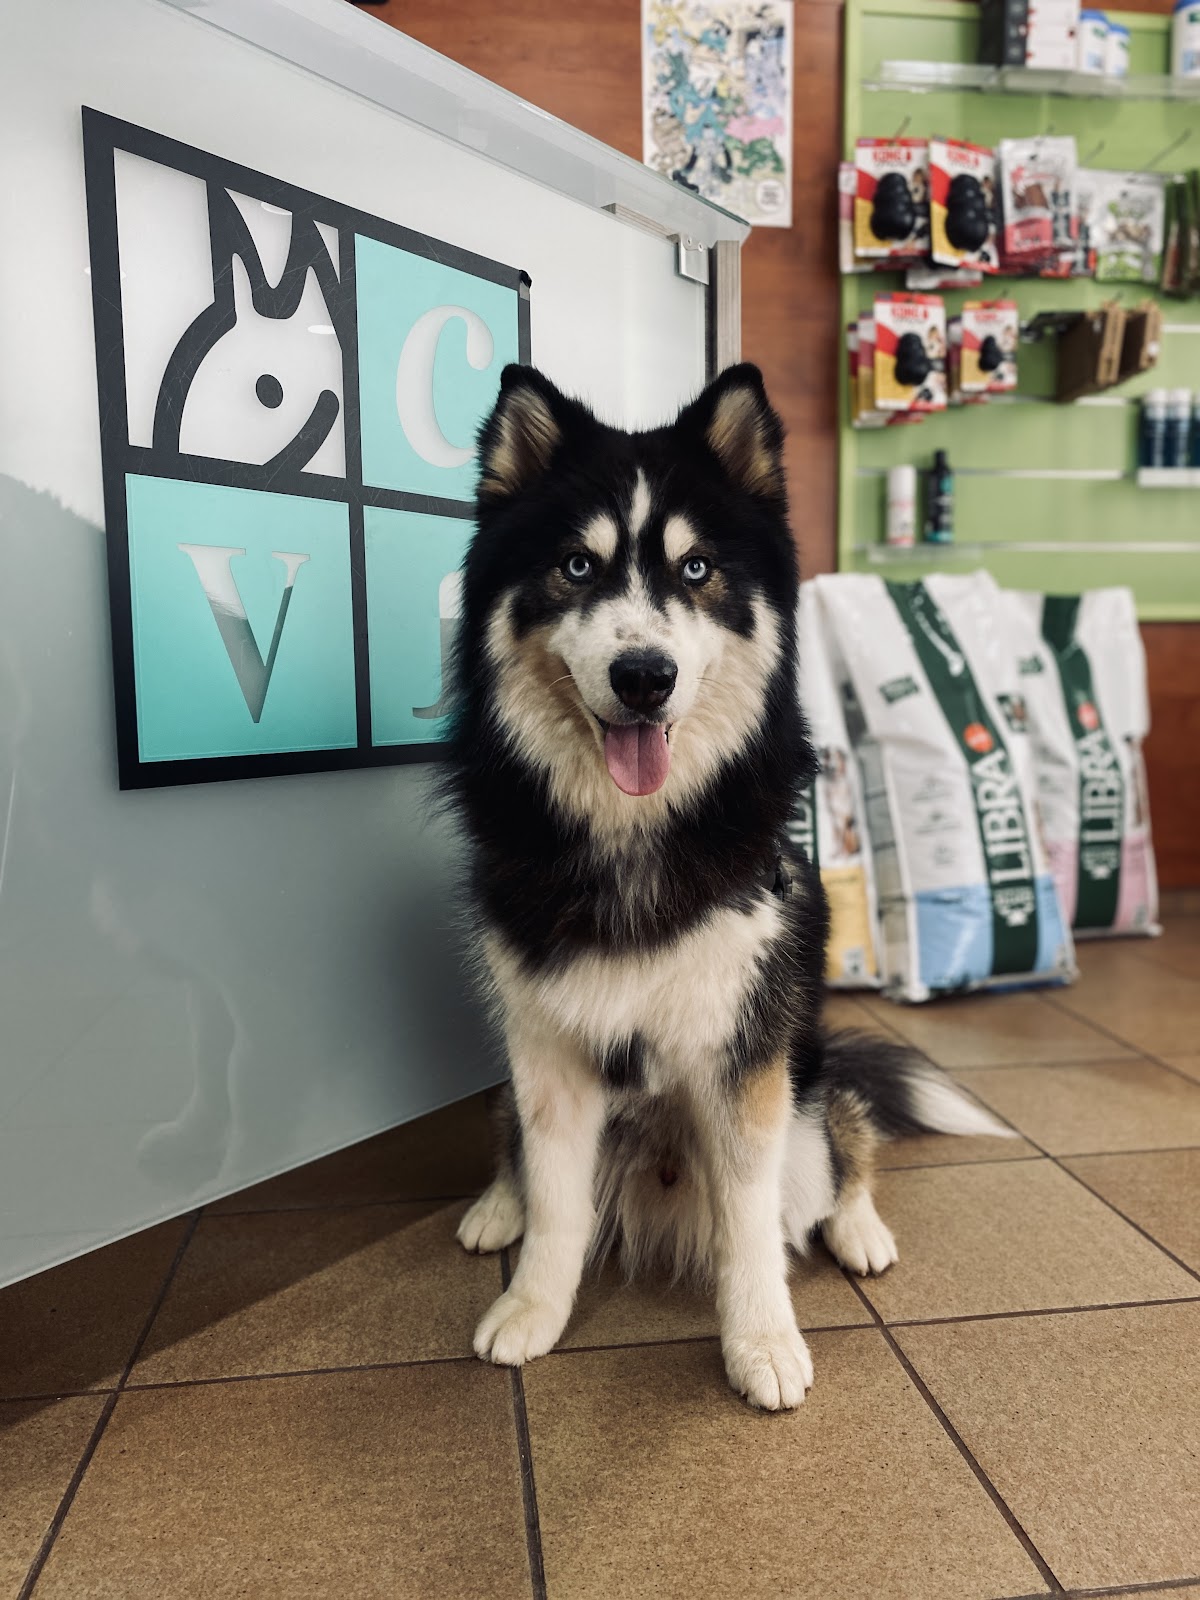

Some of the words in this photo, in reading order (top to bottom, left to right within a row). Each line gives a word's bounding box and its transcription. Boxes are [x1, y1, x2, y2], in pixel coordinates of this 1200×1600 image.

[396, 305, 494, 468] C
[178, 542, 310, 724] V
[972, 749, 1031, 884] LIBRA
[1078, 730, 1122, 842] LIBRA
